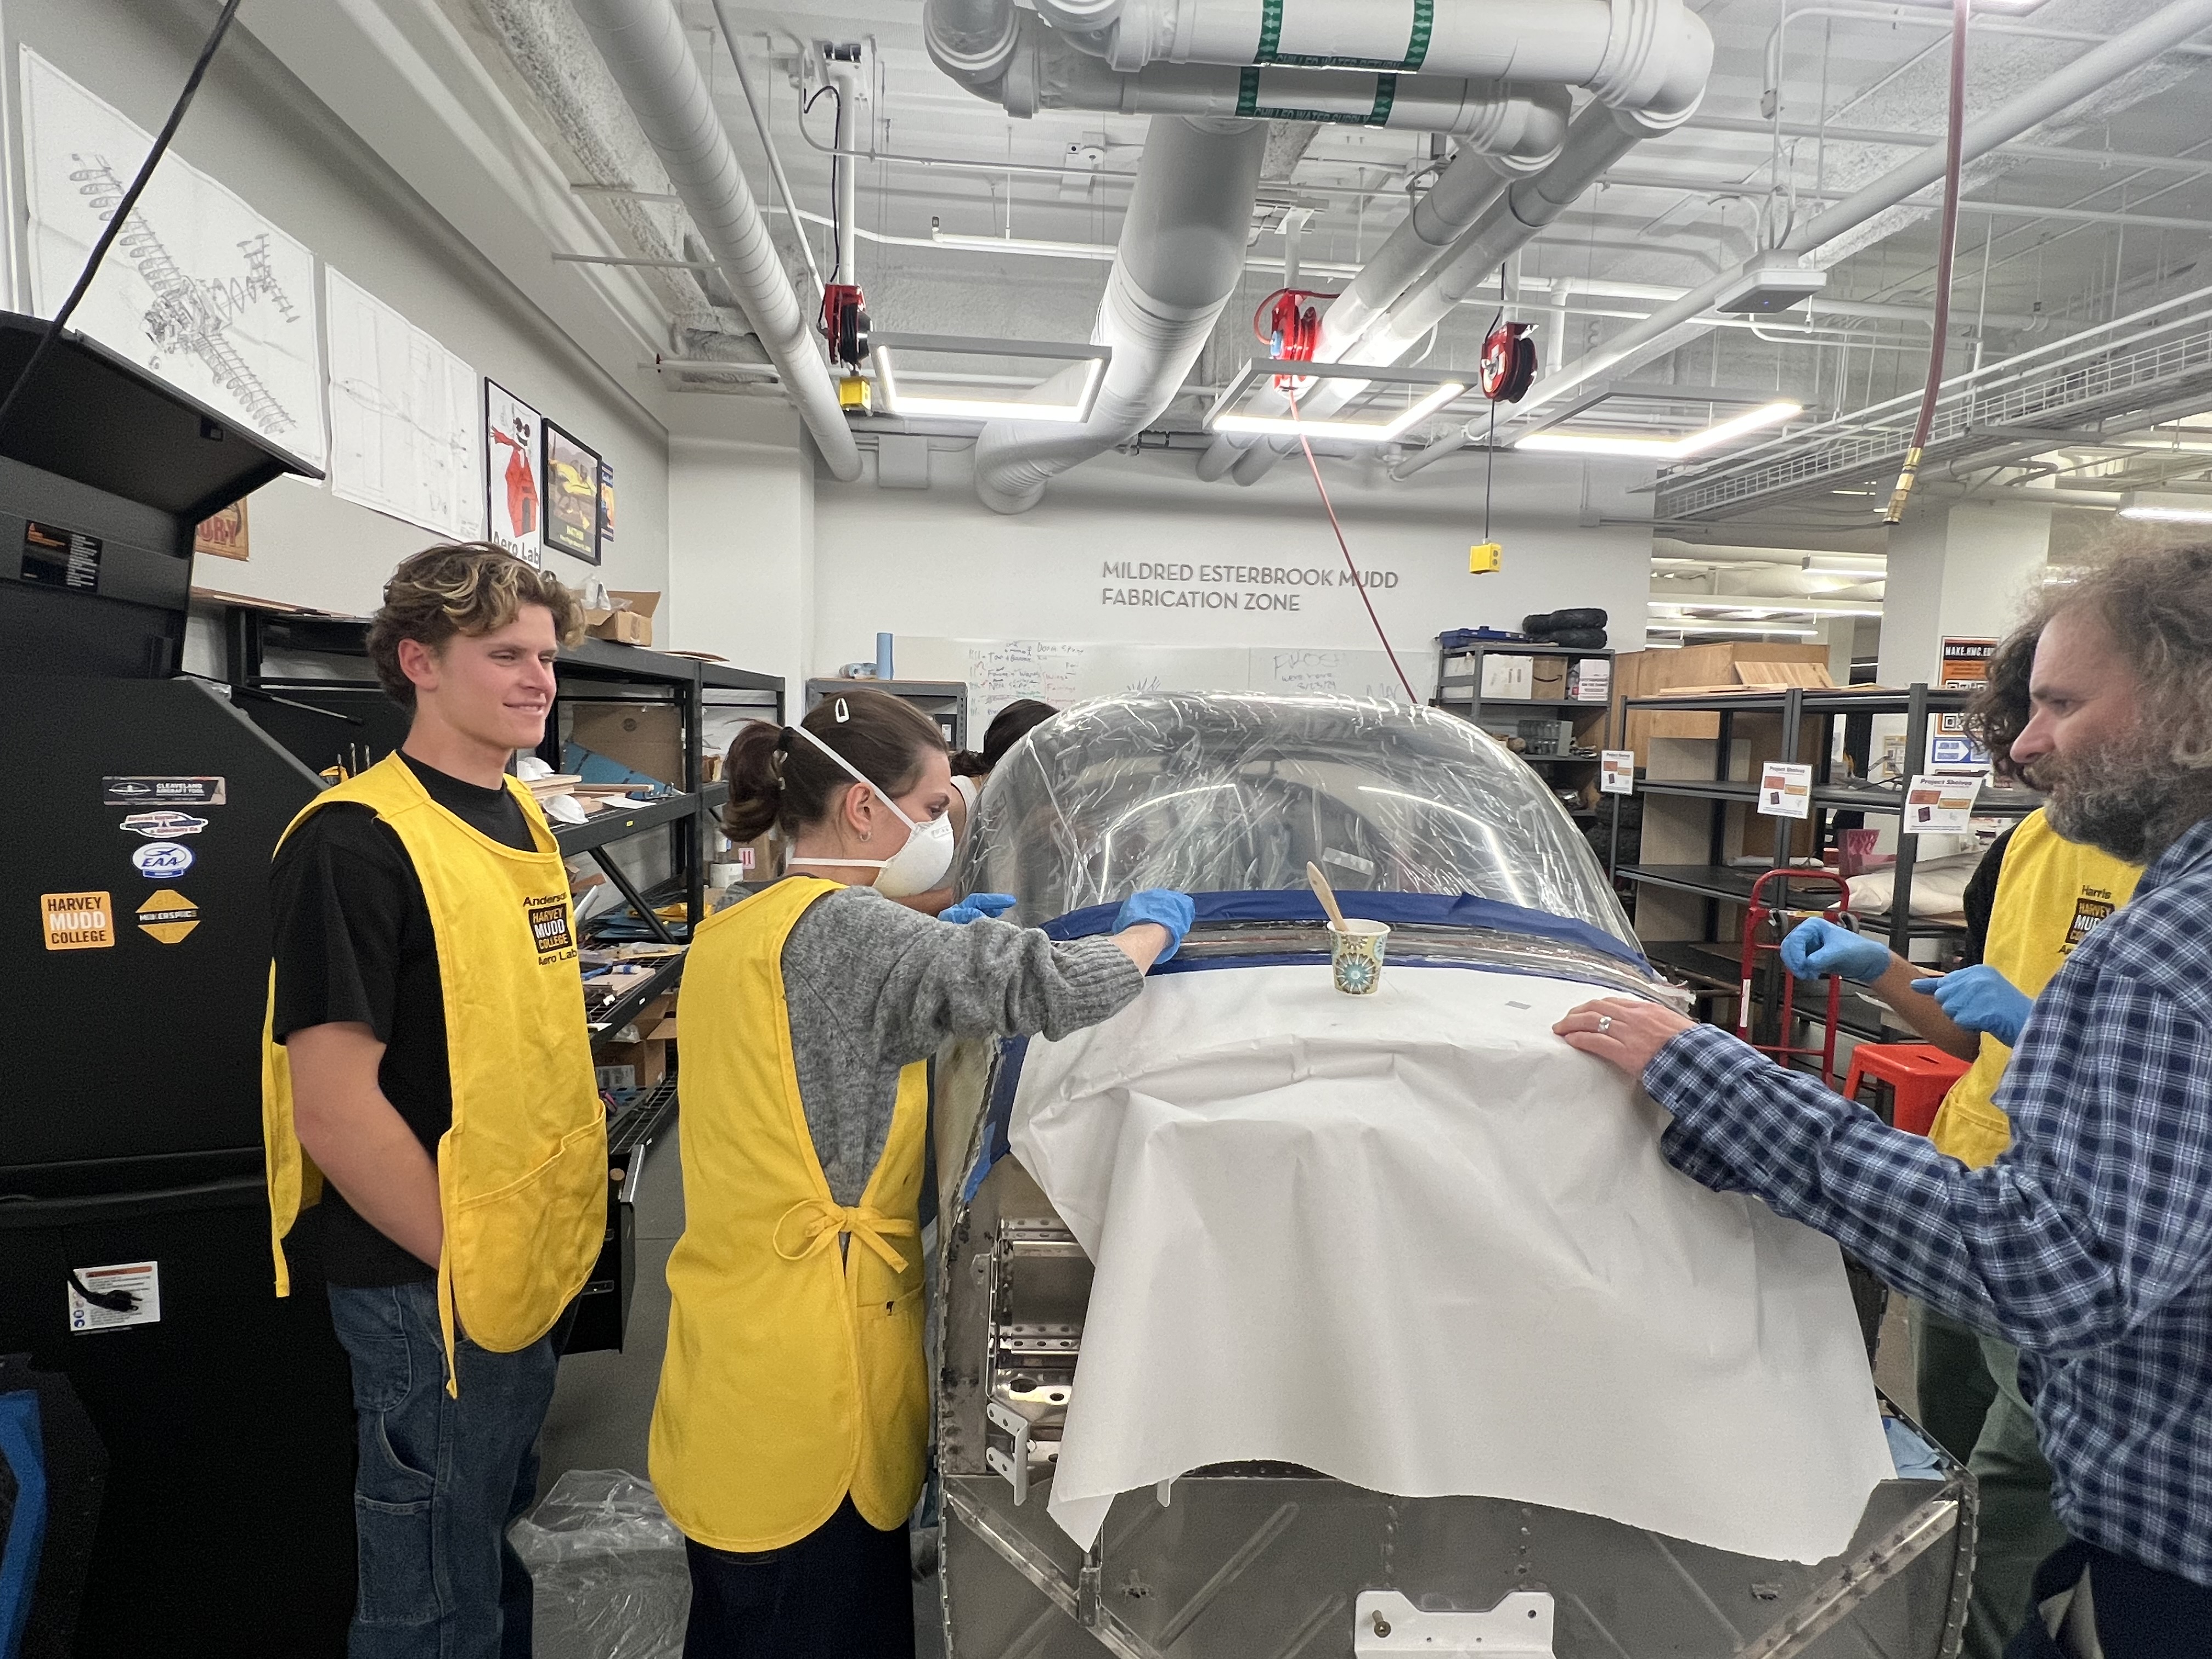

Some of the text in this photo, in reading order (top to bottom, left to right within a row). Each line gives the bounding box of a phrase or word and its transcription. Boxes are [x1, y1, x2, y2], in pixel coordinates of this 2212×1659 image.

[1276, 54, 1318, 64] CHILLED
[1320, 57, 1357, 66] WATER
[1254, 108, 1370, 125] CHILLED WATER SUPPLY
[198, 516, 236, 546] URY
[494, 531, 518, 557] Aero
[522, 542, 540, 565] Lab
[1102, 561, 1398, 588] MILDRED ESTERBROOK MUDD
[1102, 588, 1300, 611] FABRICATION ZONE
[142, 856, 178, 867] EAA
[522, 892, 567, 907] Anderso
[2082, 884, 2112, 899] Harris
[47, 896, 101, 912] HARVEY
[49, 911, 106, 931] MUDD
[533, 907, 563, 924] HARVEY
[2074, 915, 2101, 932] MUD
[52, 930, 107, 944] COLLEGE
[534, 919, 565, 939] MUDD
[539, 933, 568, 950] COLLEGE
[538, 949, 577, 966] Aero Lab
